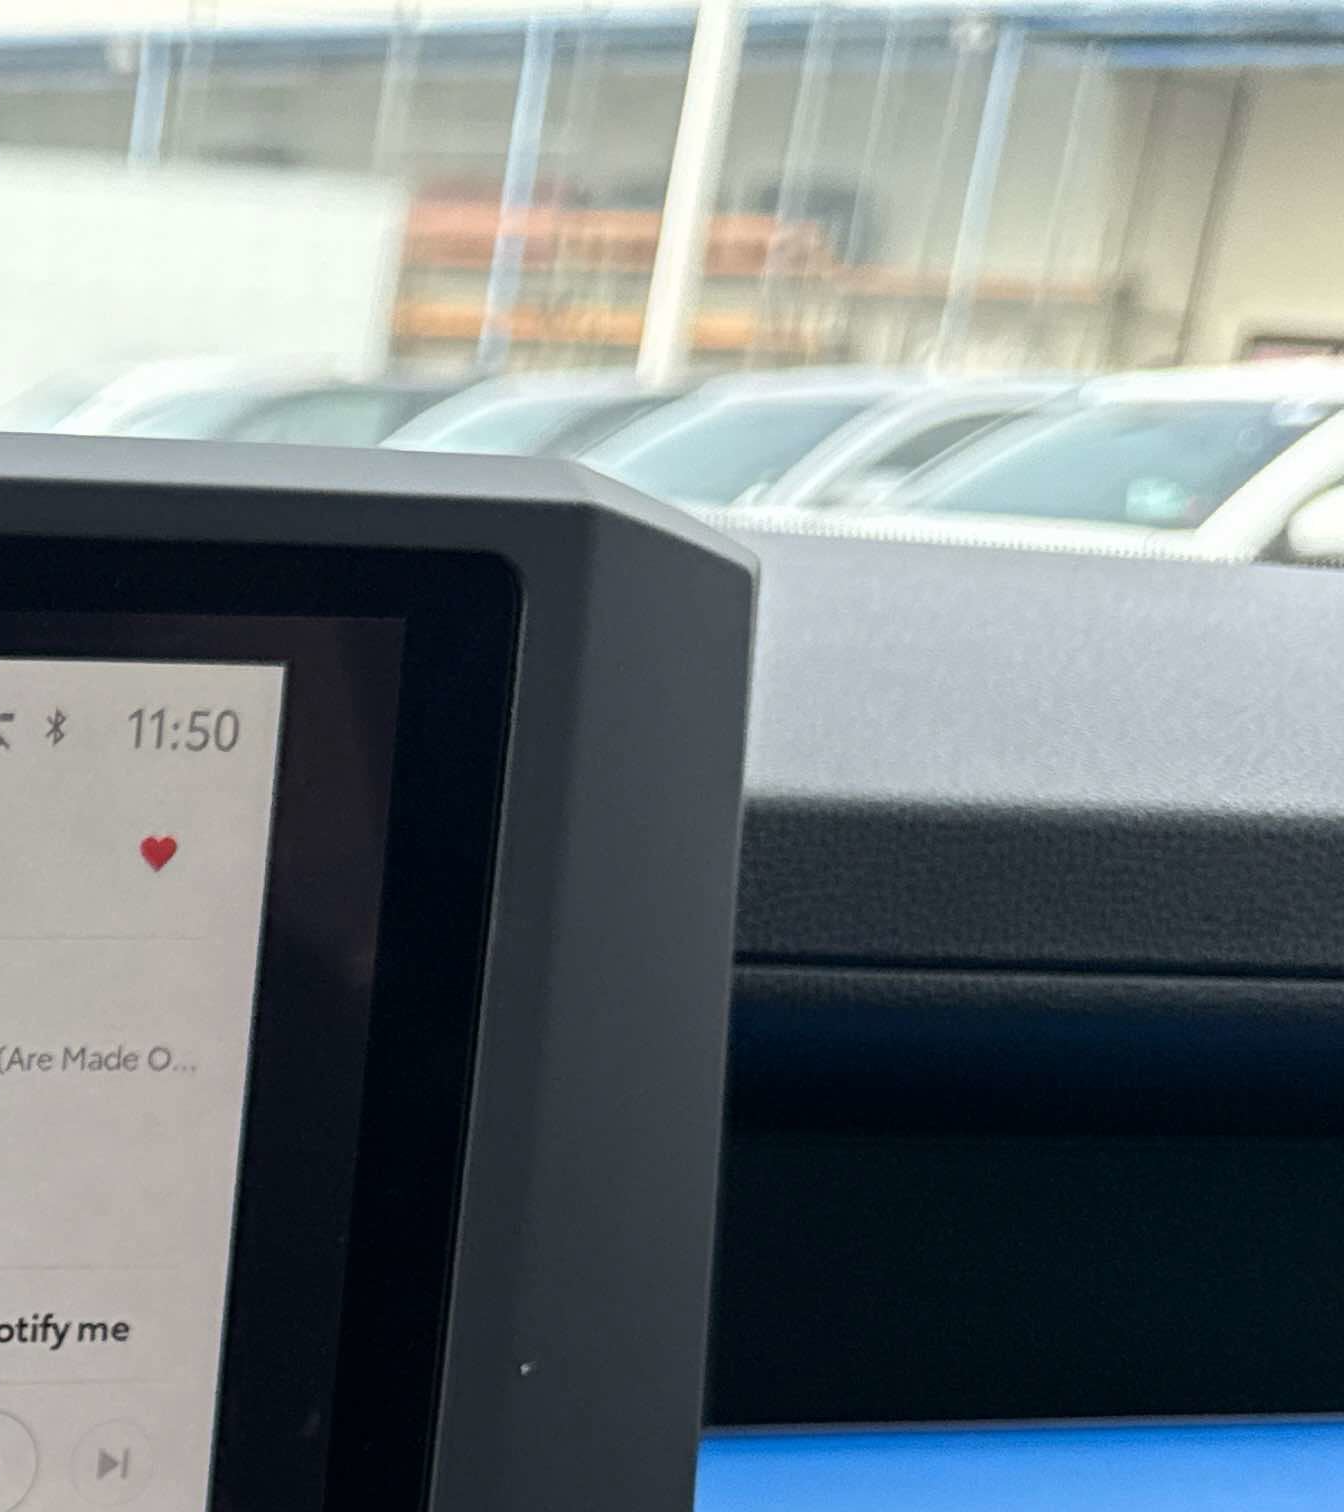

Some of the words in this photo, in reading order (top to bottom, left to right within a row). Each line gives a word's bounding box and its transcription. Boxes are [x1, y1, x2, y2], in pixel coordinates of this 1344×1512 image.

[126, 708, 242, 754] 11:50
[61, 1046, 140, 1073] Made
[77, 1319, 131, 1345] me
